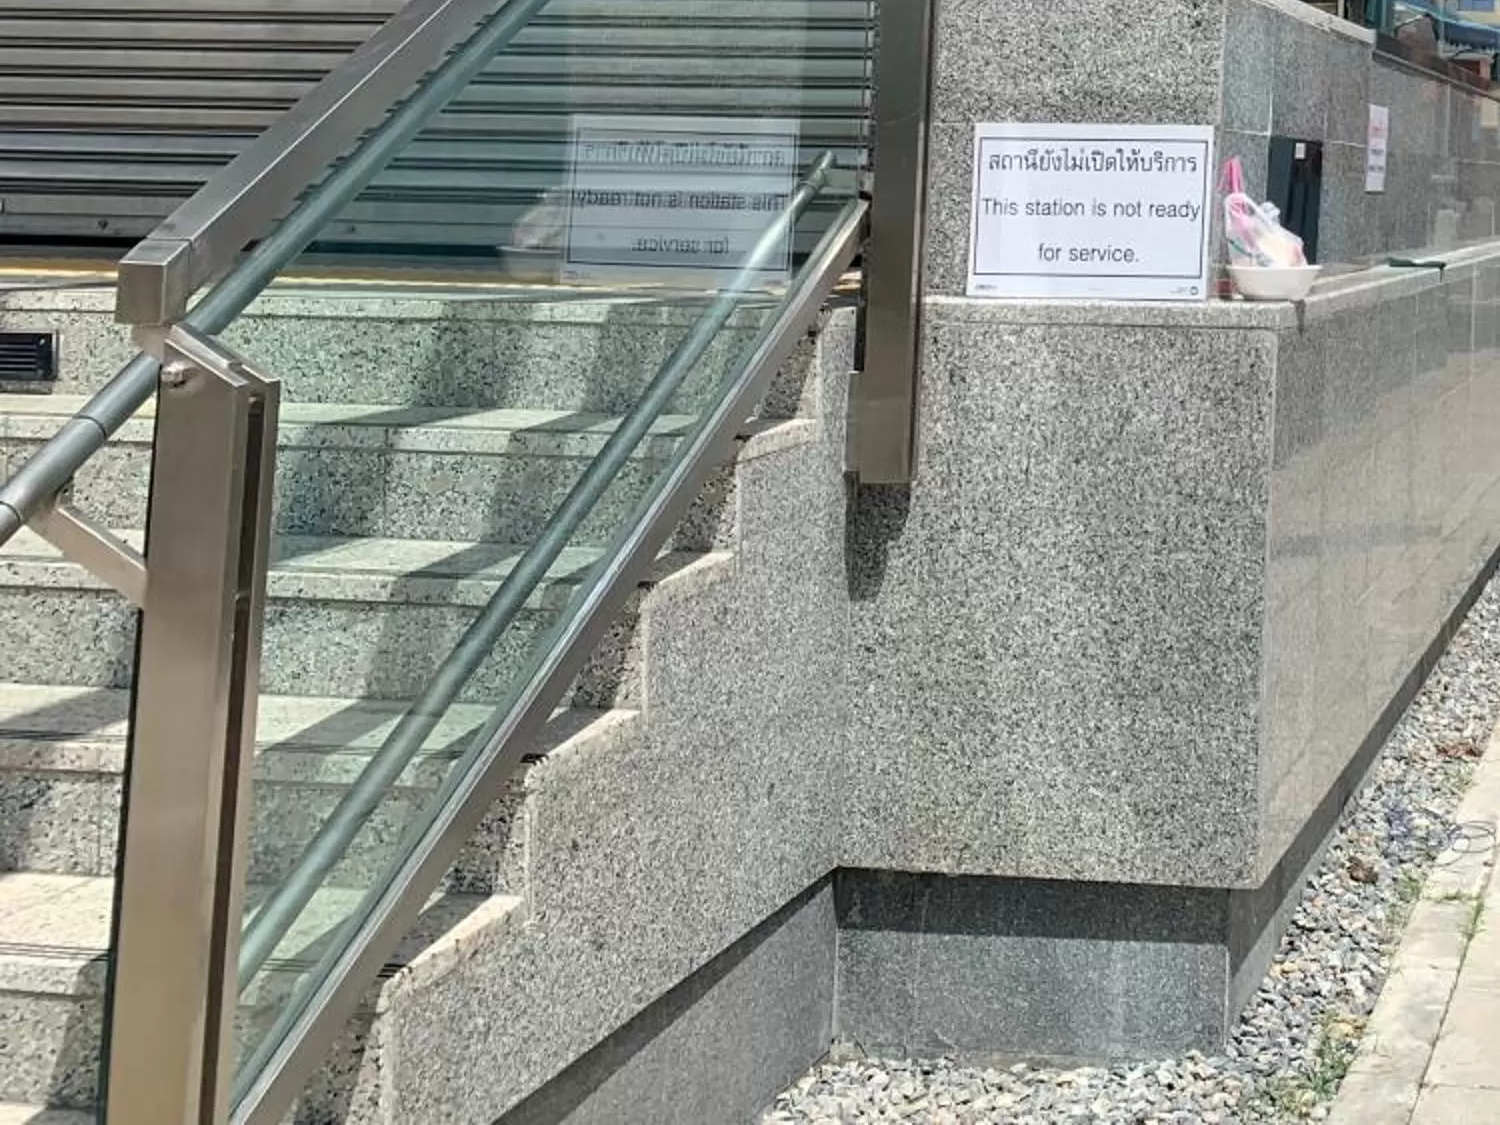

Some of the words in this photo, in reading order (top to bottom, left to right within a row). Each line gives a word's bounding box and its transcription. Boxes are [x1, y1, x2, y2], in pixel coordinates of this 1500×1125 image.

[988, 147, 1198, 173] สถานียังไม่เปิดให้บริการ
[982, 198, 1018, 216] This
[1025, 198, 1085, 216] station
[1092, 199, 1107, 217] is
[1113, 201, 1142, 217] not
[1149, 200, 1201, 221] ready
[1038, 242, 1061, 261] for
[1068, 244, 1139, 263] service.
